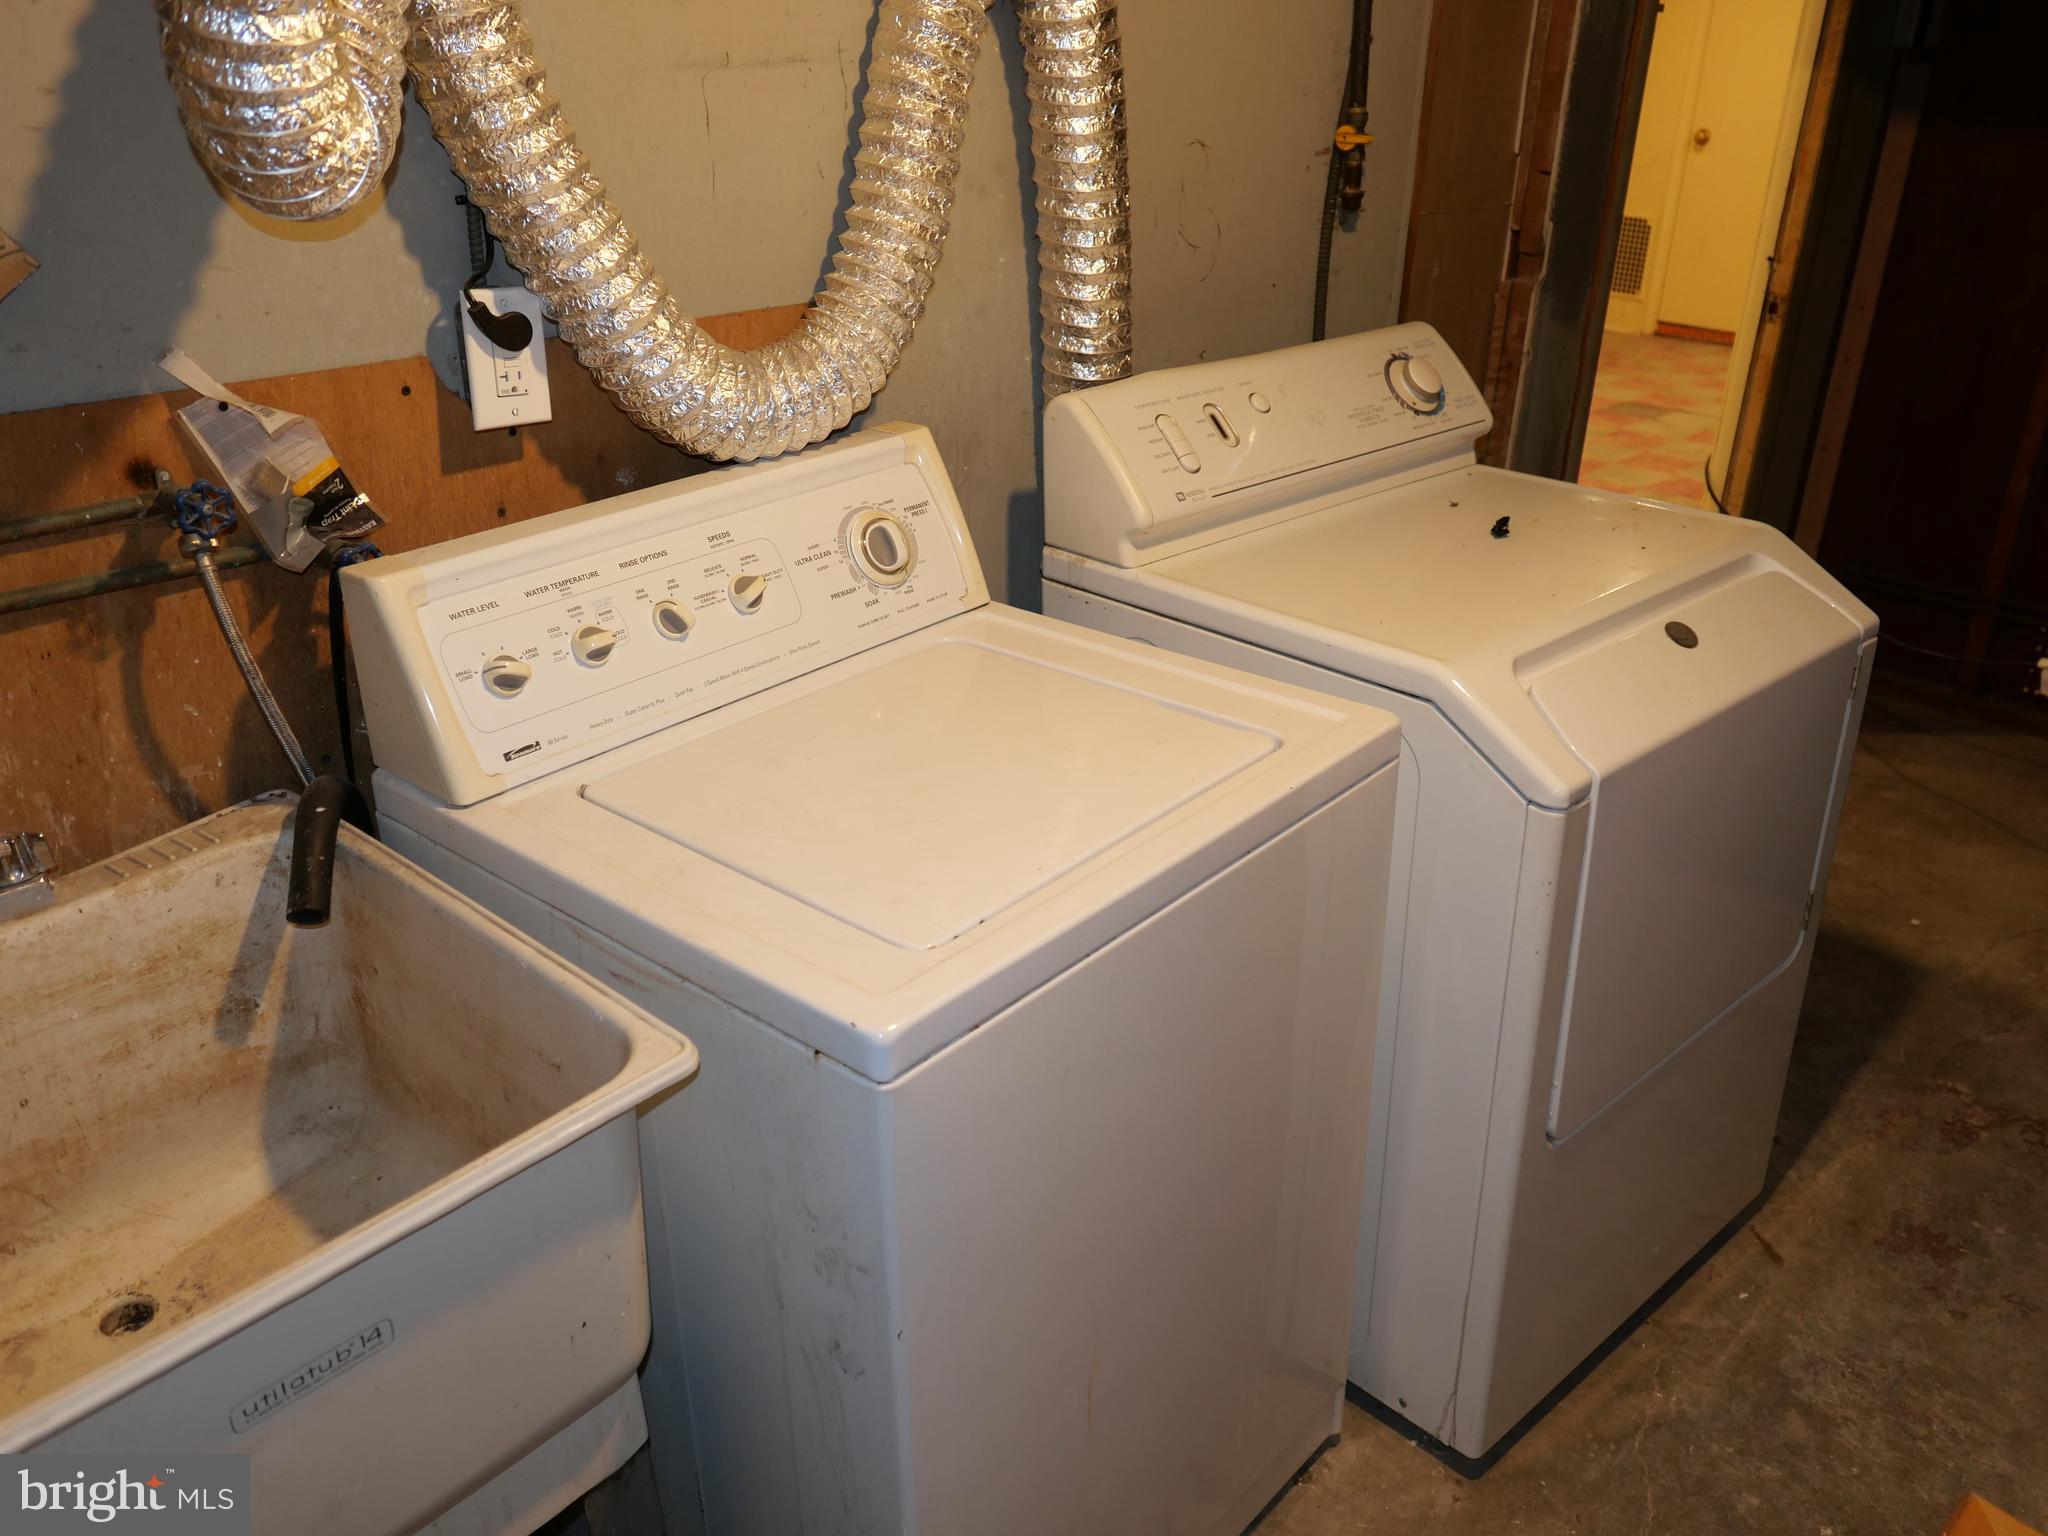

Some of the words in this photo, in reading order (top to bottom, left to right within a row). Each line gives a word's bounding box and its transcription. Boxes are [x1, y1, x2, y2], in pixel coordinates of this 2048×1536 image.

[904, 500, 930, 513] PERMANENT
[911, 509, 925, 518] PRESS
[321, 512, 342, 527] Trap
[707, 530, 731, 543] SPEEDS
[618, 558, 639, 570] RINSE
[640, 549, 668, 564] OPTIONS
[740, 553, 758, 561] NORMAL
[795, 555, 814, 567] ULTRA
[814, 549, 832, 561] CLEAN
[703, 563, 722, 573] DELICATE
[523, 584, 550, 599] WATER
[550, 570, 600, 591] TEMPERATURE
[667, 583, 680, 591] RINSE
[636, 593, 649, 601] RINSE
[830, 587, 857, 600] PREWASH
[864, 598, 880, 608] SOAK
[448, 606, 476, 621] WATER
[476, 600, 500, 615] LEVEL
[566, 605, 582, 613] WARM
[598, 608, 613, 617] WARM
[547, 626, 560, 634] COLD
[522, 647, 538, 655] LARGE
[552, 649, 563, 657] HOT
[525, 652, 539, 660] LOAD
[554, 655, 566, 663] COLD
[455, 668, 473, 678] SMALL
[458, 674, 473, 683] LOAD
[242, 1350, 352, 1418] utilatub
[360, 1326, 382, 1348] 14
